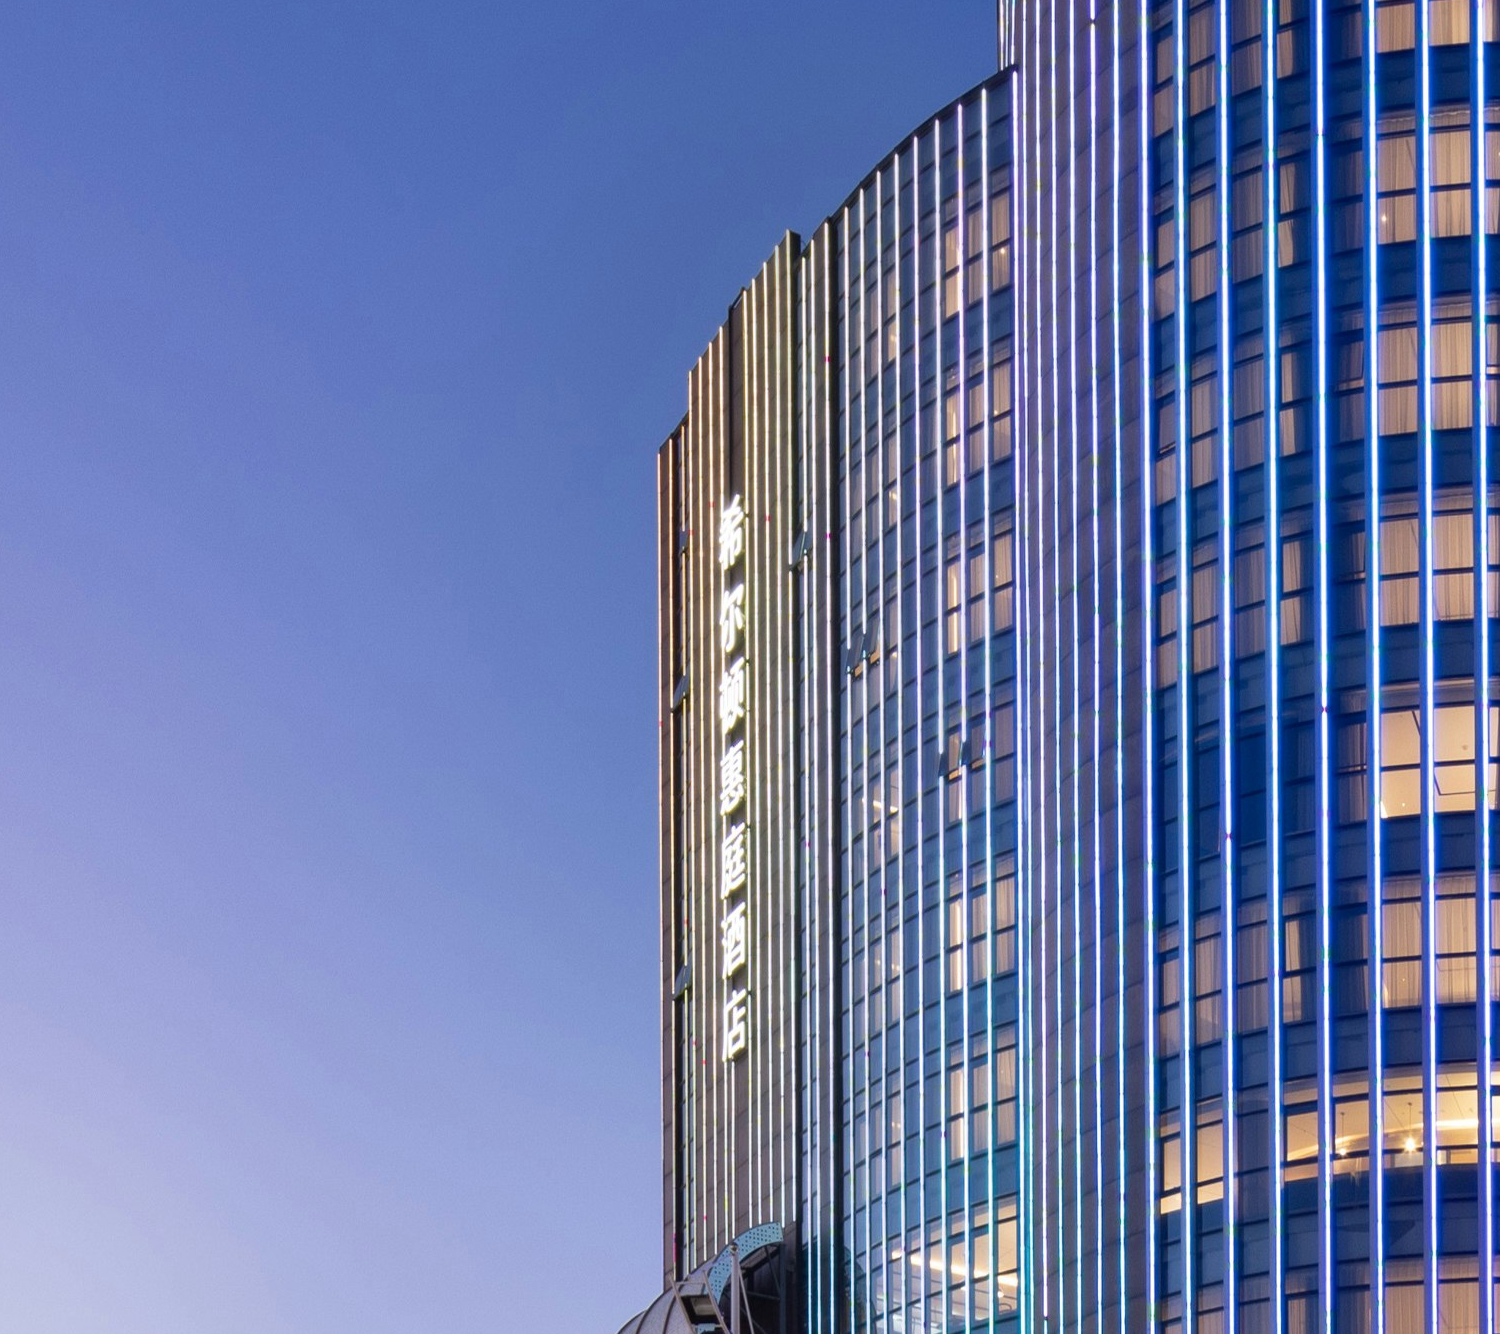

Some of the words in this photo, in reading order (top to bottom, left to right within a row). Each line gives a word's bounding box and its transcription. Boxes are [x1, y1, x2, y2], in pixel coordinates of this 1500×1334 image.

[718, 494, 747, 1063] 希尔顿惠庭酒店
